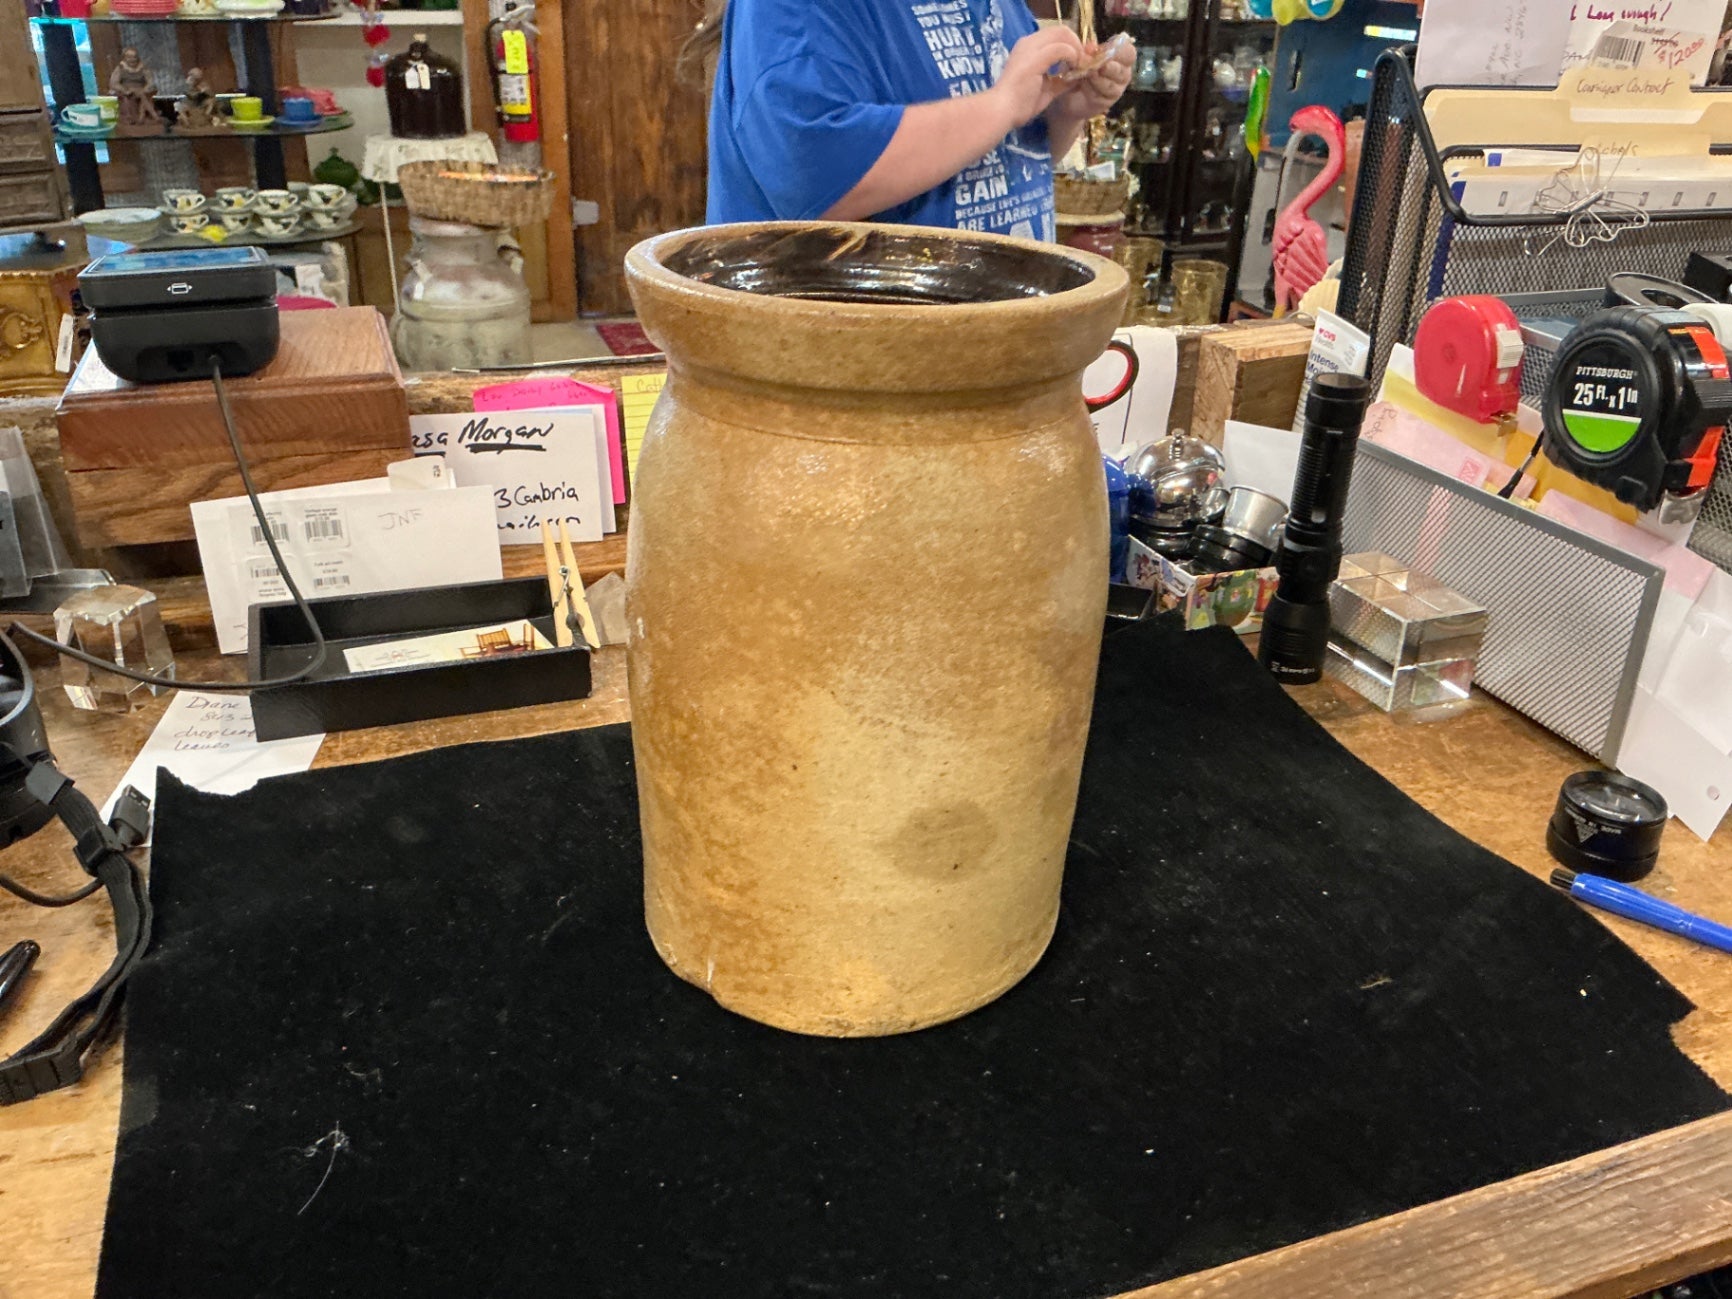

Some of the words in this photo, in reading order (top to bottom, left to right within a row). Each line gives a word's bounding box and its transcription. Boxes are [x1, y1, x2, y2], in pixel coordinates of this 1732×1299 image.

[923, 25, 975, 51] HURT
[937, 55, 985, 79] KNOW
[955, 175, 1008, 206] GAIN
[955, 201, 996, 220] BECAUSE
[957, 216, 986, 231] ARE
[1323, 330, 1336, 341] CVS
[1310, 349, 1339, 371] Intense
[1576, 366, 1633, 379] PITTSBURGH
[1573, 383, 1594, 406] 25
[1618, 386, 1625, 410] 1
[458, 417, 554, 445] Morgan
[514, 481, 579, 506] Cambria
